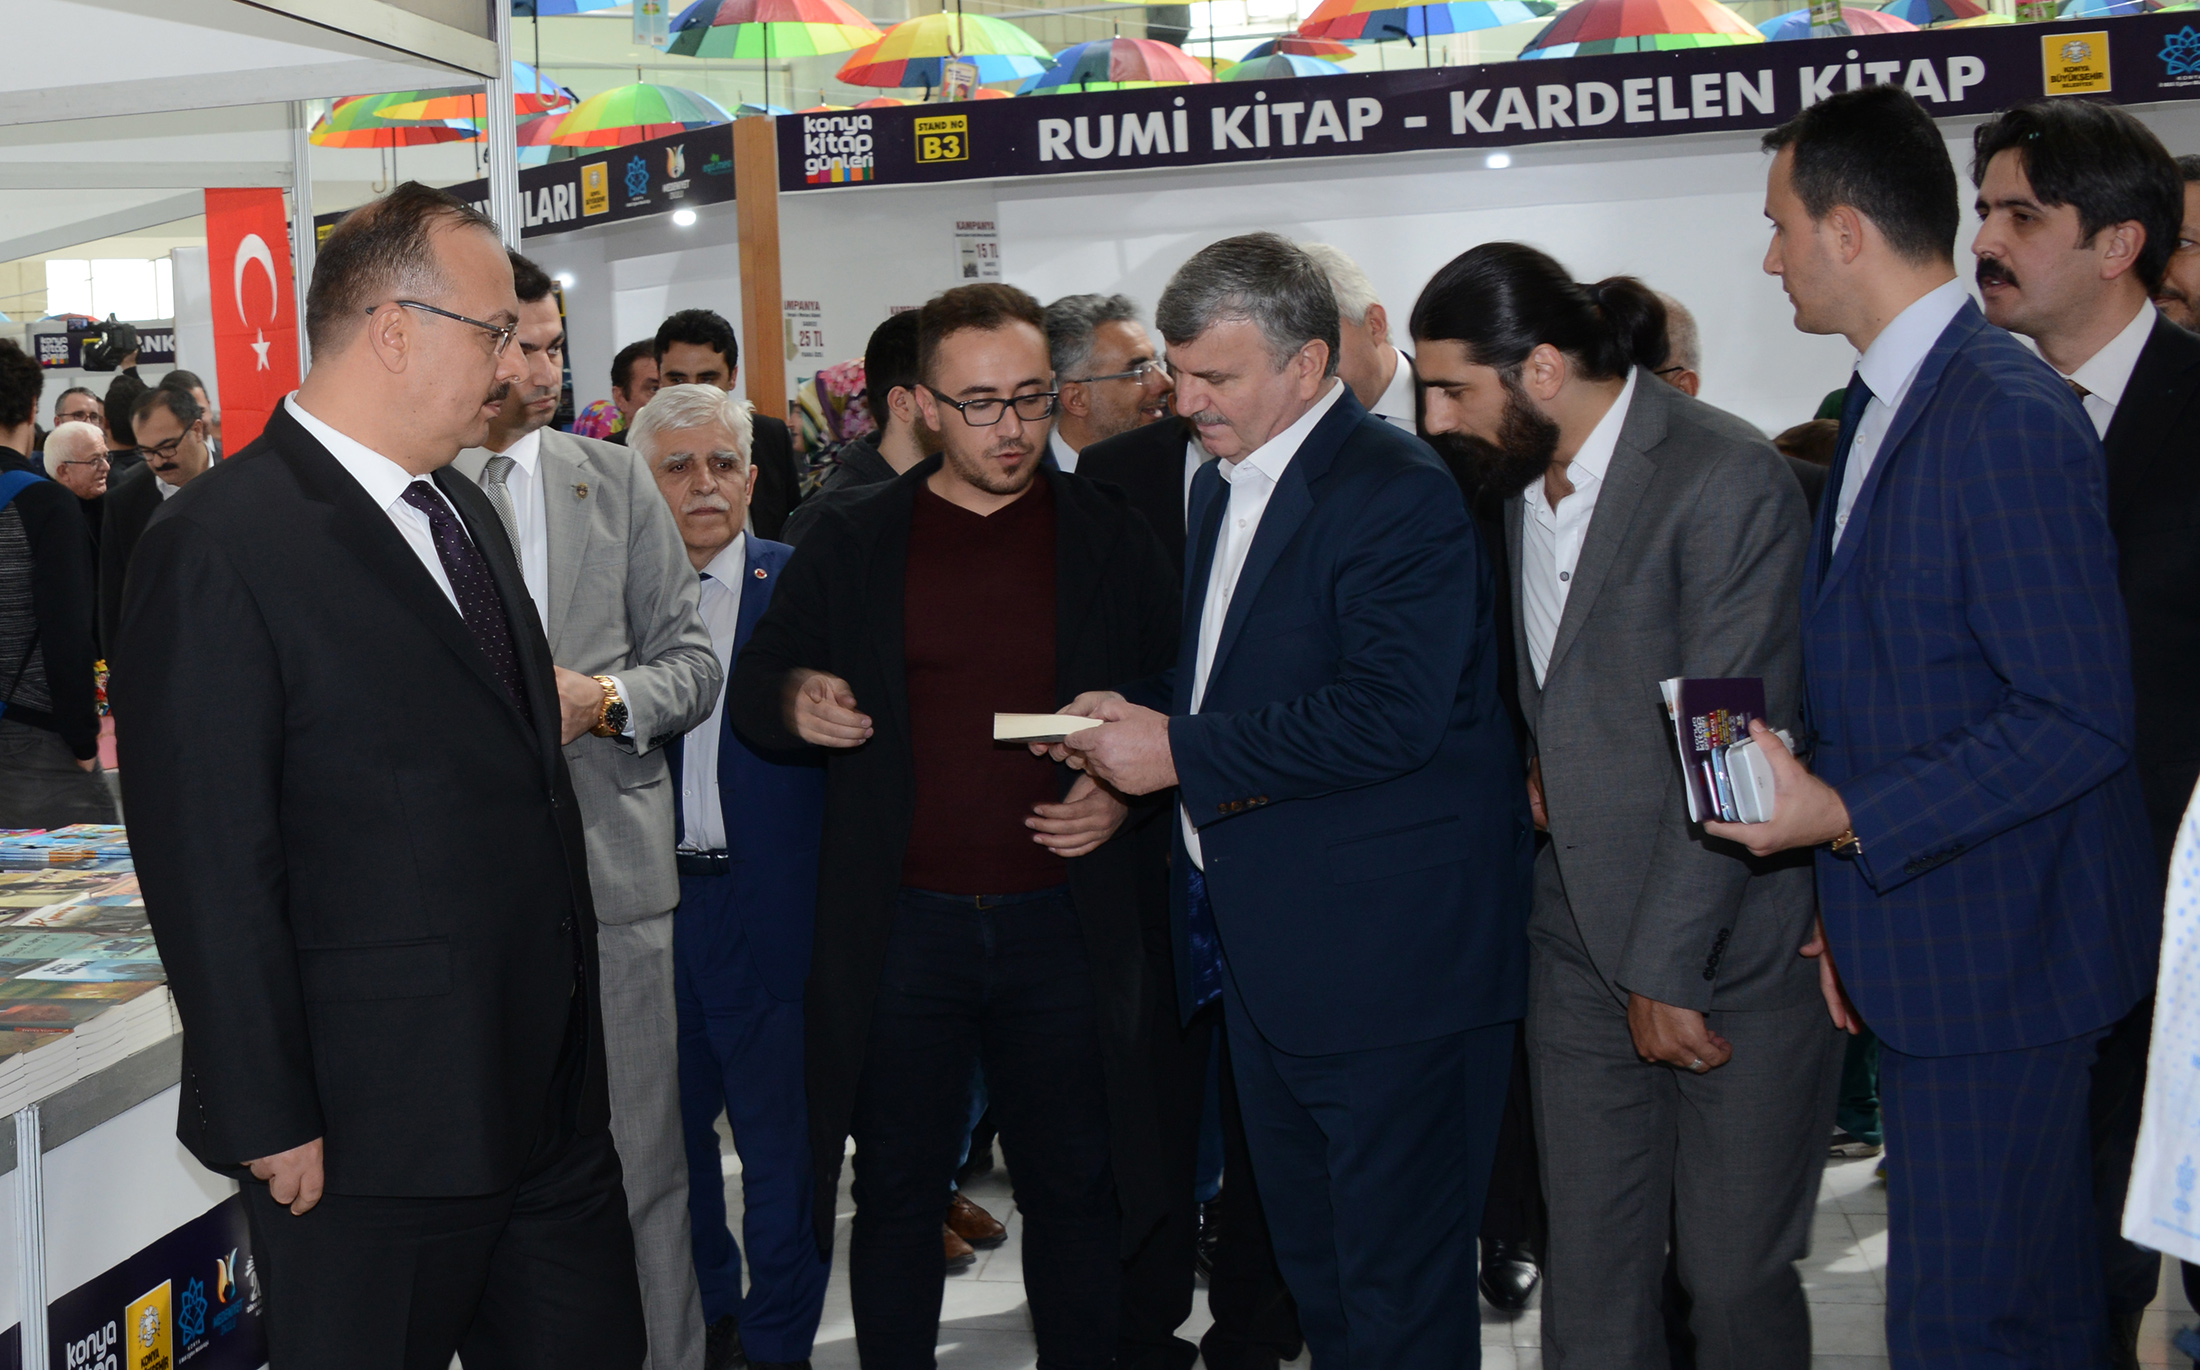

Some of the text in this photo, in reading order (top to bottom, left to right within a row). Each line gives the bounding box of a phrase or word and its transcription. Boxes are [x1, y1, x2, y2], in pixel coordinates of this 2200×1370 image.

[804, 115, 873, 135] konya
[918, 120, 964, 132] STAND NO
[1038, 96, 1189, 162] RUMİ
[1211, 91, 1383, 151] KİTAP
[1450, 68, 1775, 135] KARDELEN
[804, 133, 873, 155] kitap
[923, 135, 961, 160] B3
[805, 152, 874, 175] günleri
[799, 330, 824, 347] 25 TL
[66, 1320, 117, 1370] konya
